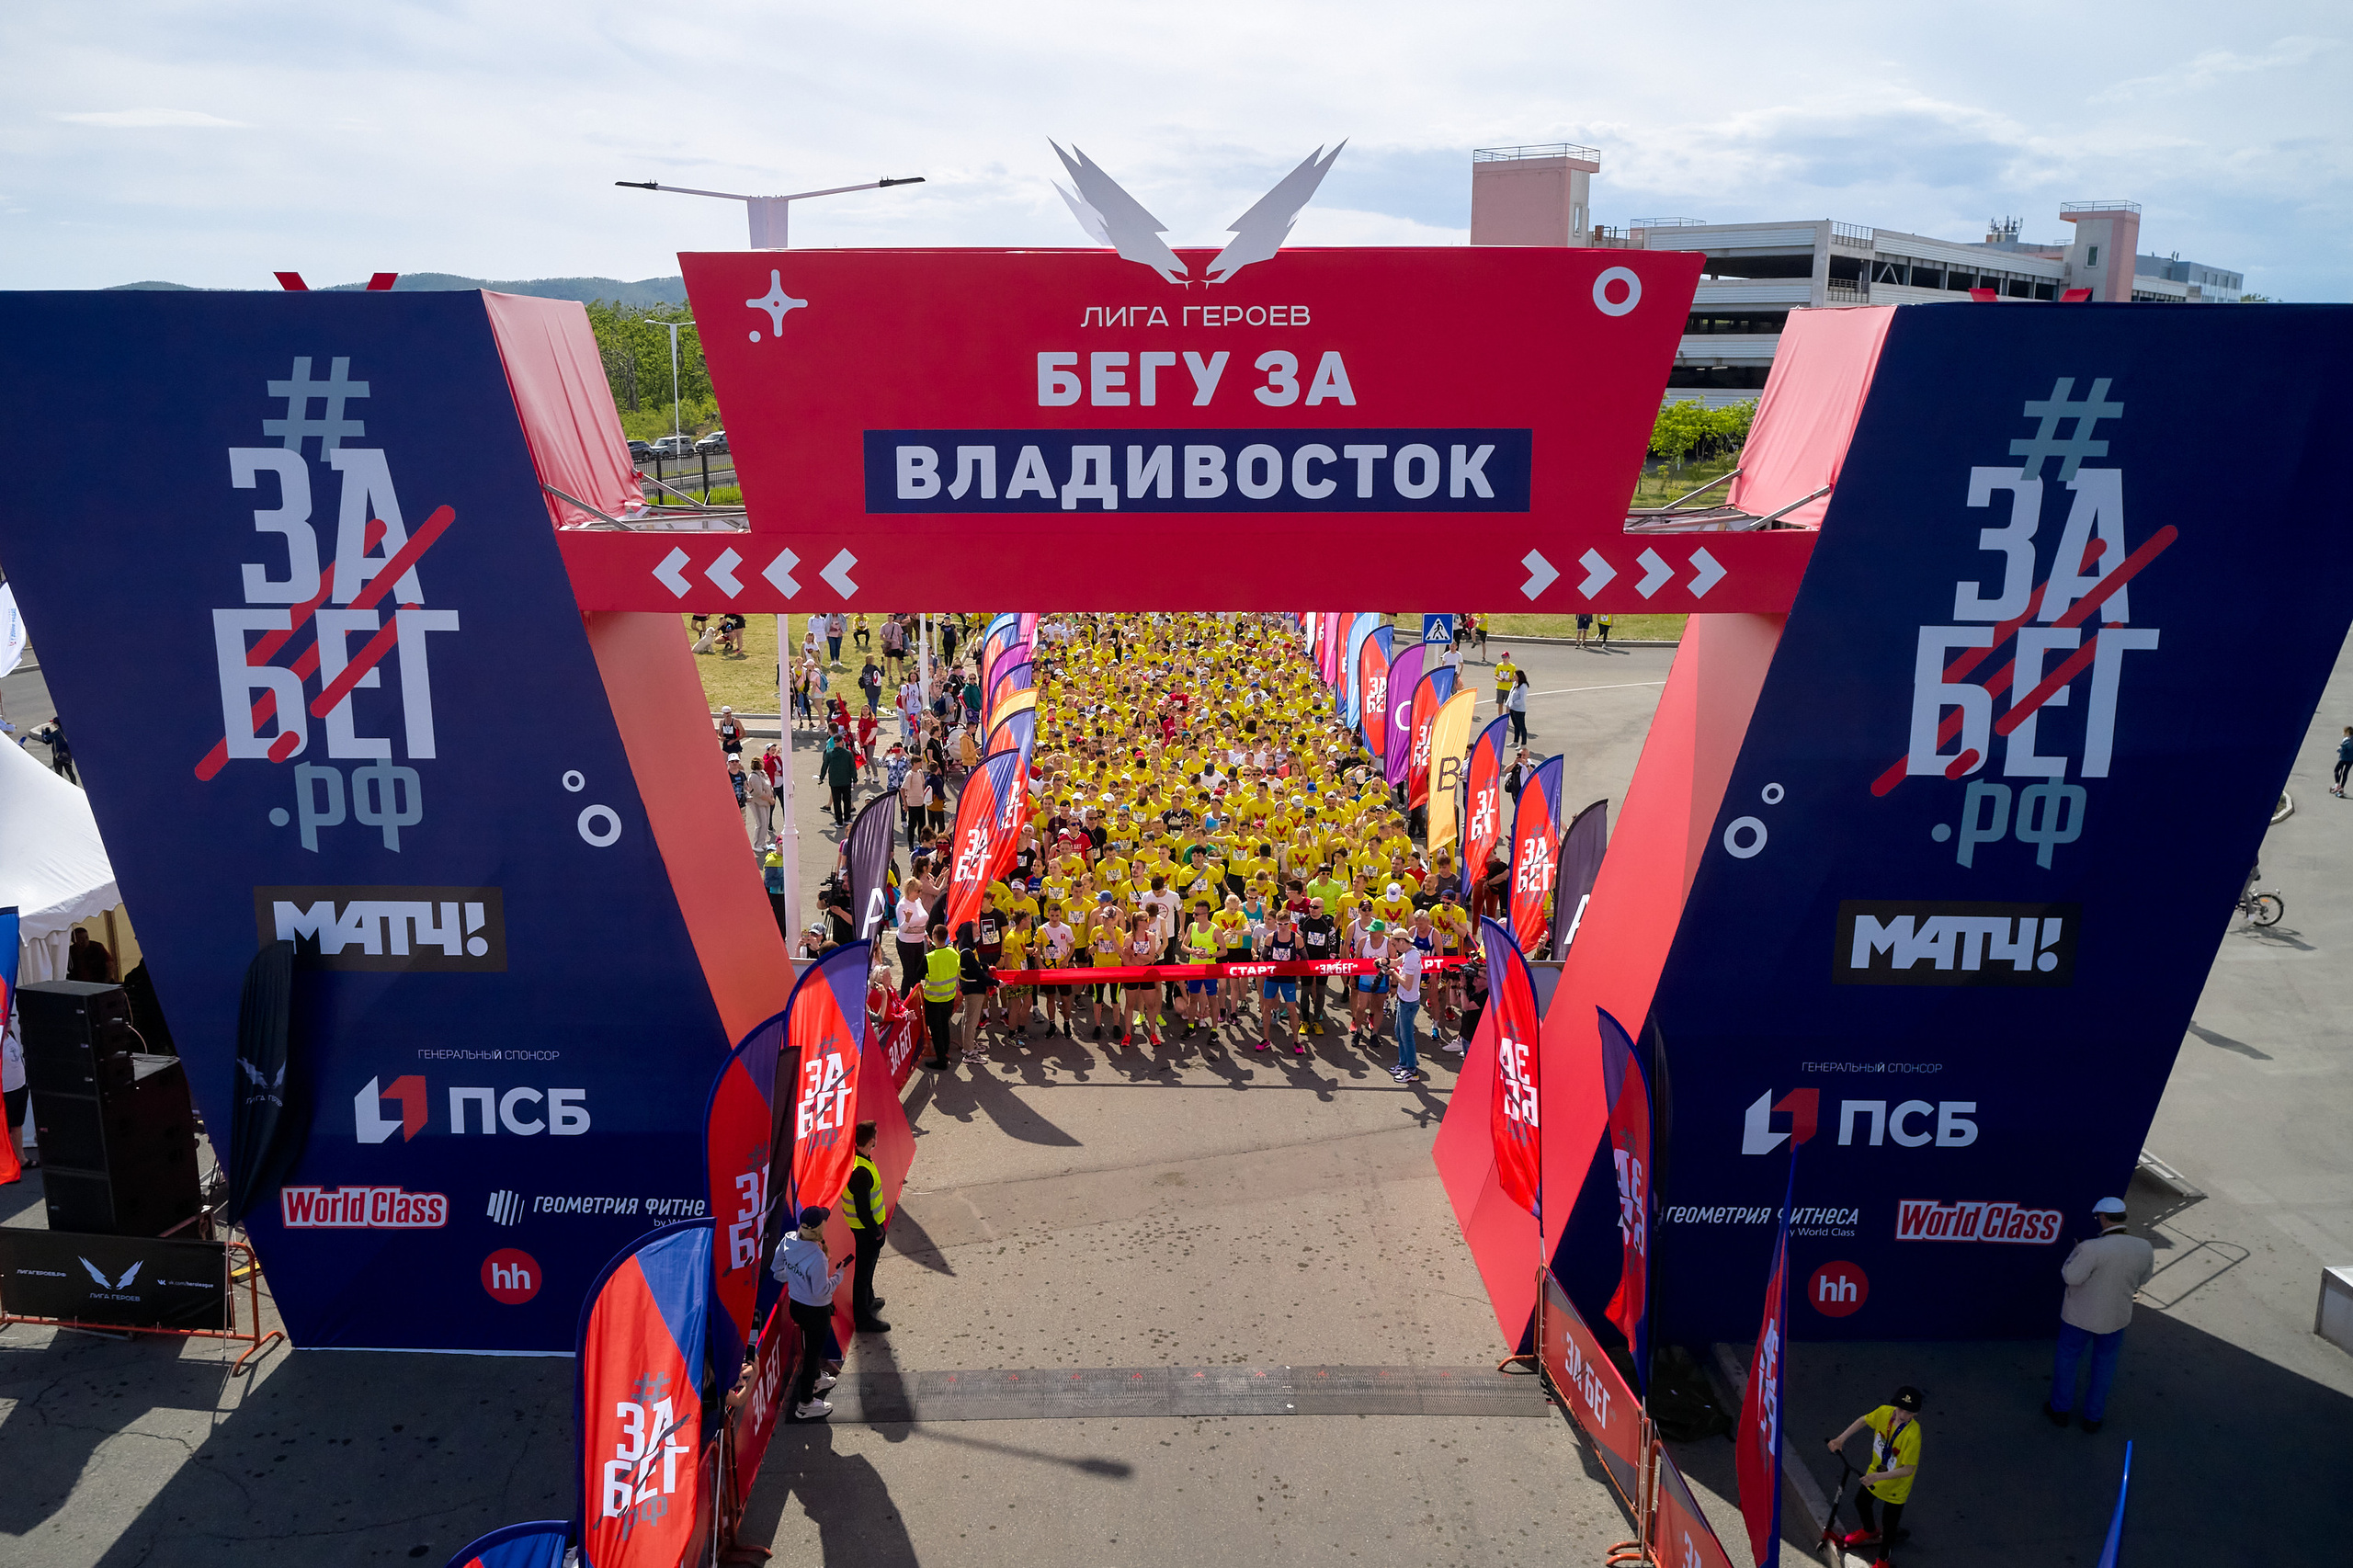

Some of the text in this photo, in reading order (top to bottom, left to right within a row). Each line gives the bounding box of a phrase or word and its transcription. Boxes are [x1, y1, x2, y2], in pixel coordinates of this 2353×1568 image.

[1080, 306, 1311, 327] ЛИГА ГЕРОЕВ
[1037, 350, 1358, 407] БЕГУ ЗА
[895, 444, 1496, 511] ВЛАДИВОСТОК
[229, 448, 425, 604] ЗА
[1953, 466, 2130, 623] ЗА
[212, 608, 460, 759] БЕГ
[1367, 695, 1386, 713] БЕ
[1906, 626, 2160, 778] БЕГ
[964, 827, 988, 857] ЗА
[1522, 836, 1550, 869] ЗА
[954, 854, 992, 882] БЕГ
[1518, 863, 1555, 893] БЕГ
[273, 901, 489, 958] МАТЧ!
[1850, 915, 2063, 972] МАТЧ!
[1421, 959, 1444, 971] АРТ
[417, 1049, 561, 1061] ГЕНЕРАЛЬНЫЙ СПОНСОР
[805, 1052, 847, 1100] ЗА
[1802, 1062, 1943, 1074] ГЕНЕРАЛЬНЫЙ СПОНСОР
[449, 1086, 591, 1136] ПСБ
[798, 1087, 853, 1140] БЕГ
[1837, 1099, 1979, 1147] ПСБ
[286, 1191, 443, 1223] World Class
[1901, 1204, 2058, 1240] World Class
[1798, 1228, 1829, 1236] World
[1831, 1227, 1856, 1237] Class
[89, 1292, 142, 1302] ЛИГА ГЕРОЕВ
[492, 1262, 531, 1290] hh
[1818, 1275, 1858, 1302] hh
[753, 1334, 781, 1437] ЗА БЕГ
[1564, 1331, 1611, 1430] ЗА БЕГ
[617, 1395, 677, 1461] ЗА
[603, 1446, 690, 1517] БЕГ
